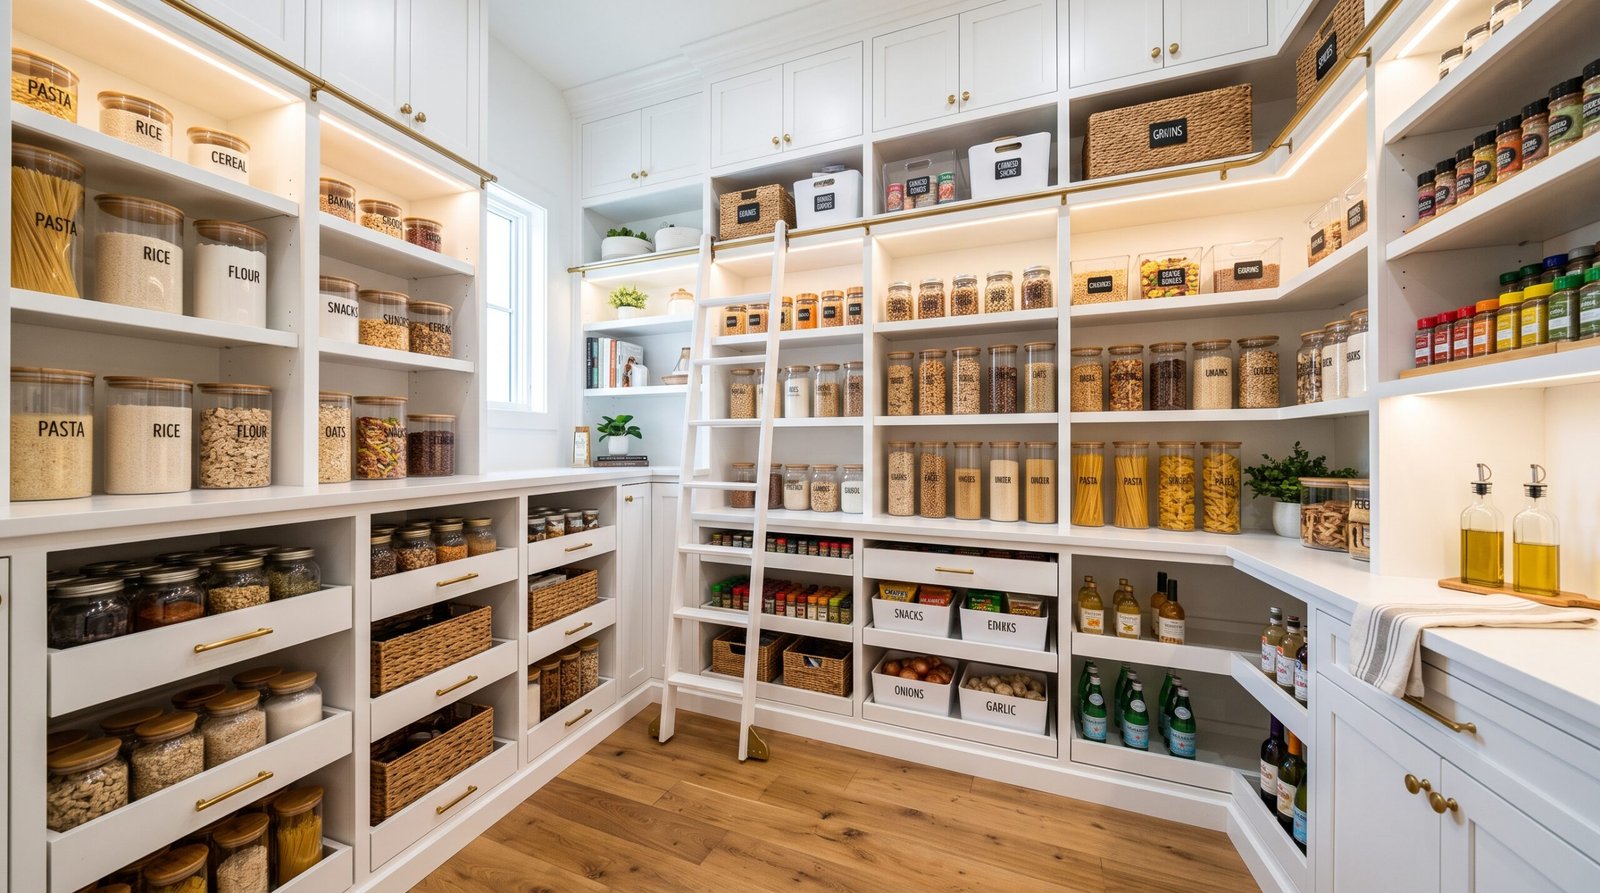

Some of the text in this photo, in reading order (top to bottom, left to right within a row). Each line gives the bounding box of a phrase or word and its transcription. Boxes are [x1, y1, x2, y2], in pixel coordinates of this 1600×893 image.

[28, 79, 72, 110] PASTA
[136, 119, 163, 141] RICE
[211, 150, 248, 174] CEREAL
[35, 212, 77, 236] PASTA
[143, 245, 171, 265] RICE
[228, 265, 260, 284] FLOUR
[327, 301, 359, 318] SNACKS
[38, 420, 85, 438] PASTA
[153, 423, 181, 438] RICE
[236, 424, 268, 438] FLOUR
[325, 426, 346, 438] OATS
[1079, 476, 1098, 485] PASTA
[1123, 476, 1143, 486] PASTA
[894, 608, 924, 622] SNACKS
[894, 684, 925, 700] ONIONS
[985, 700, 1017, 716] GARLIC
